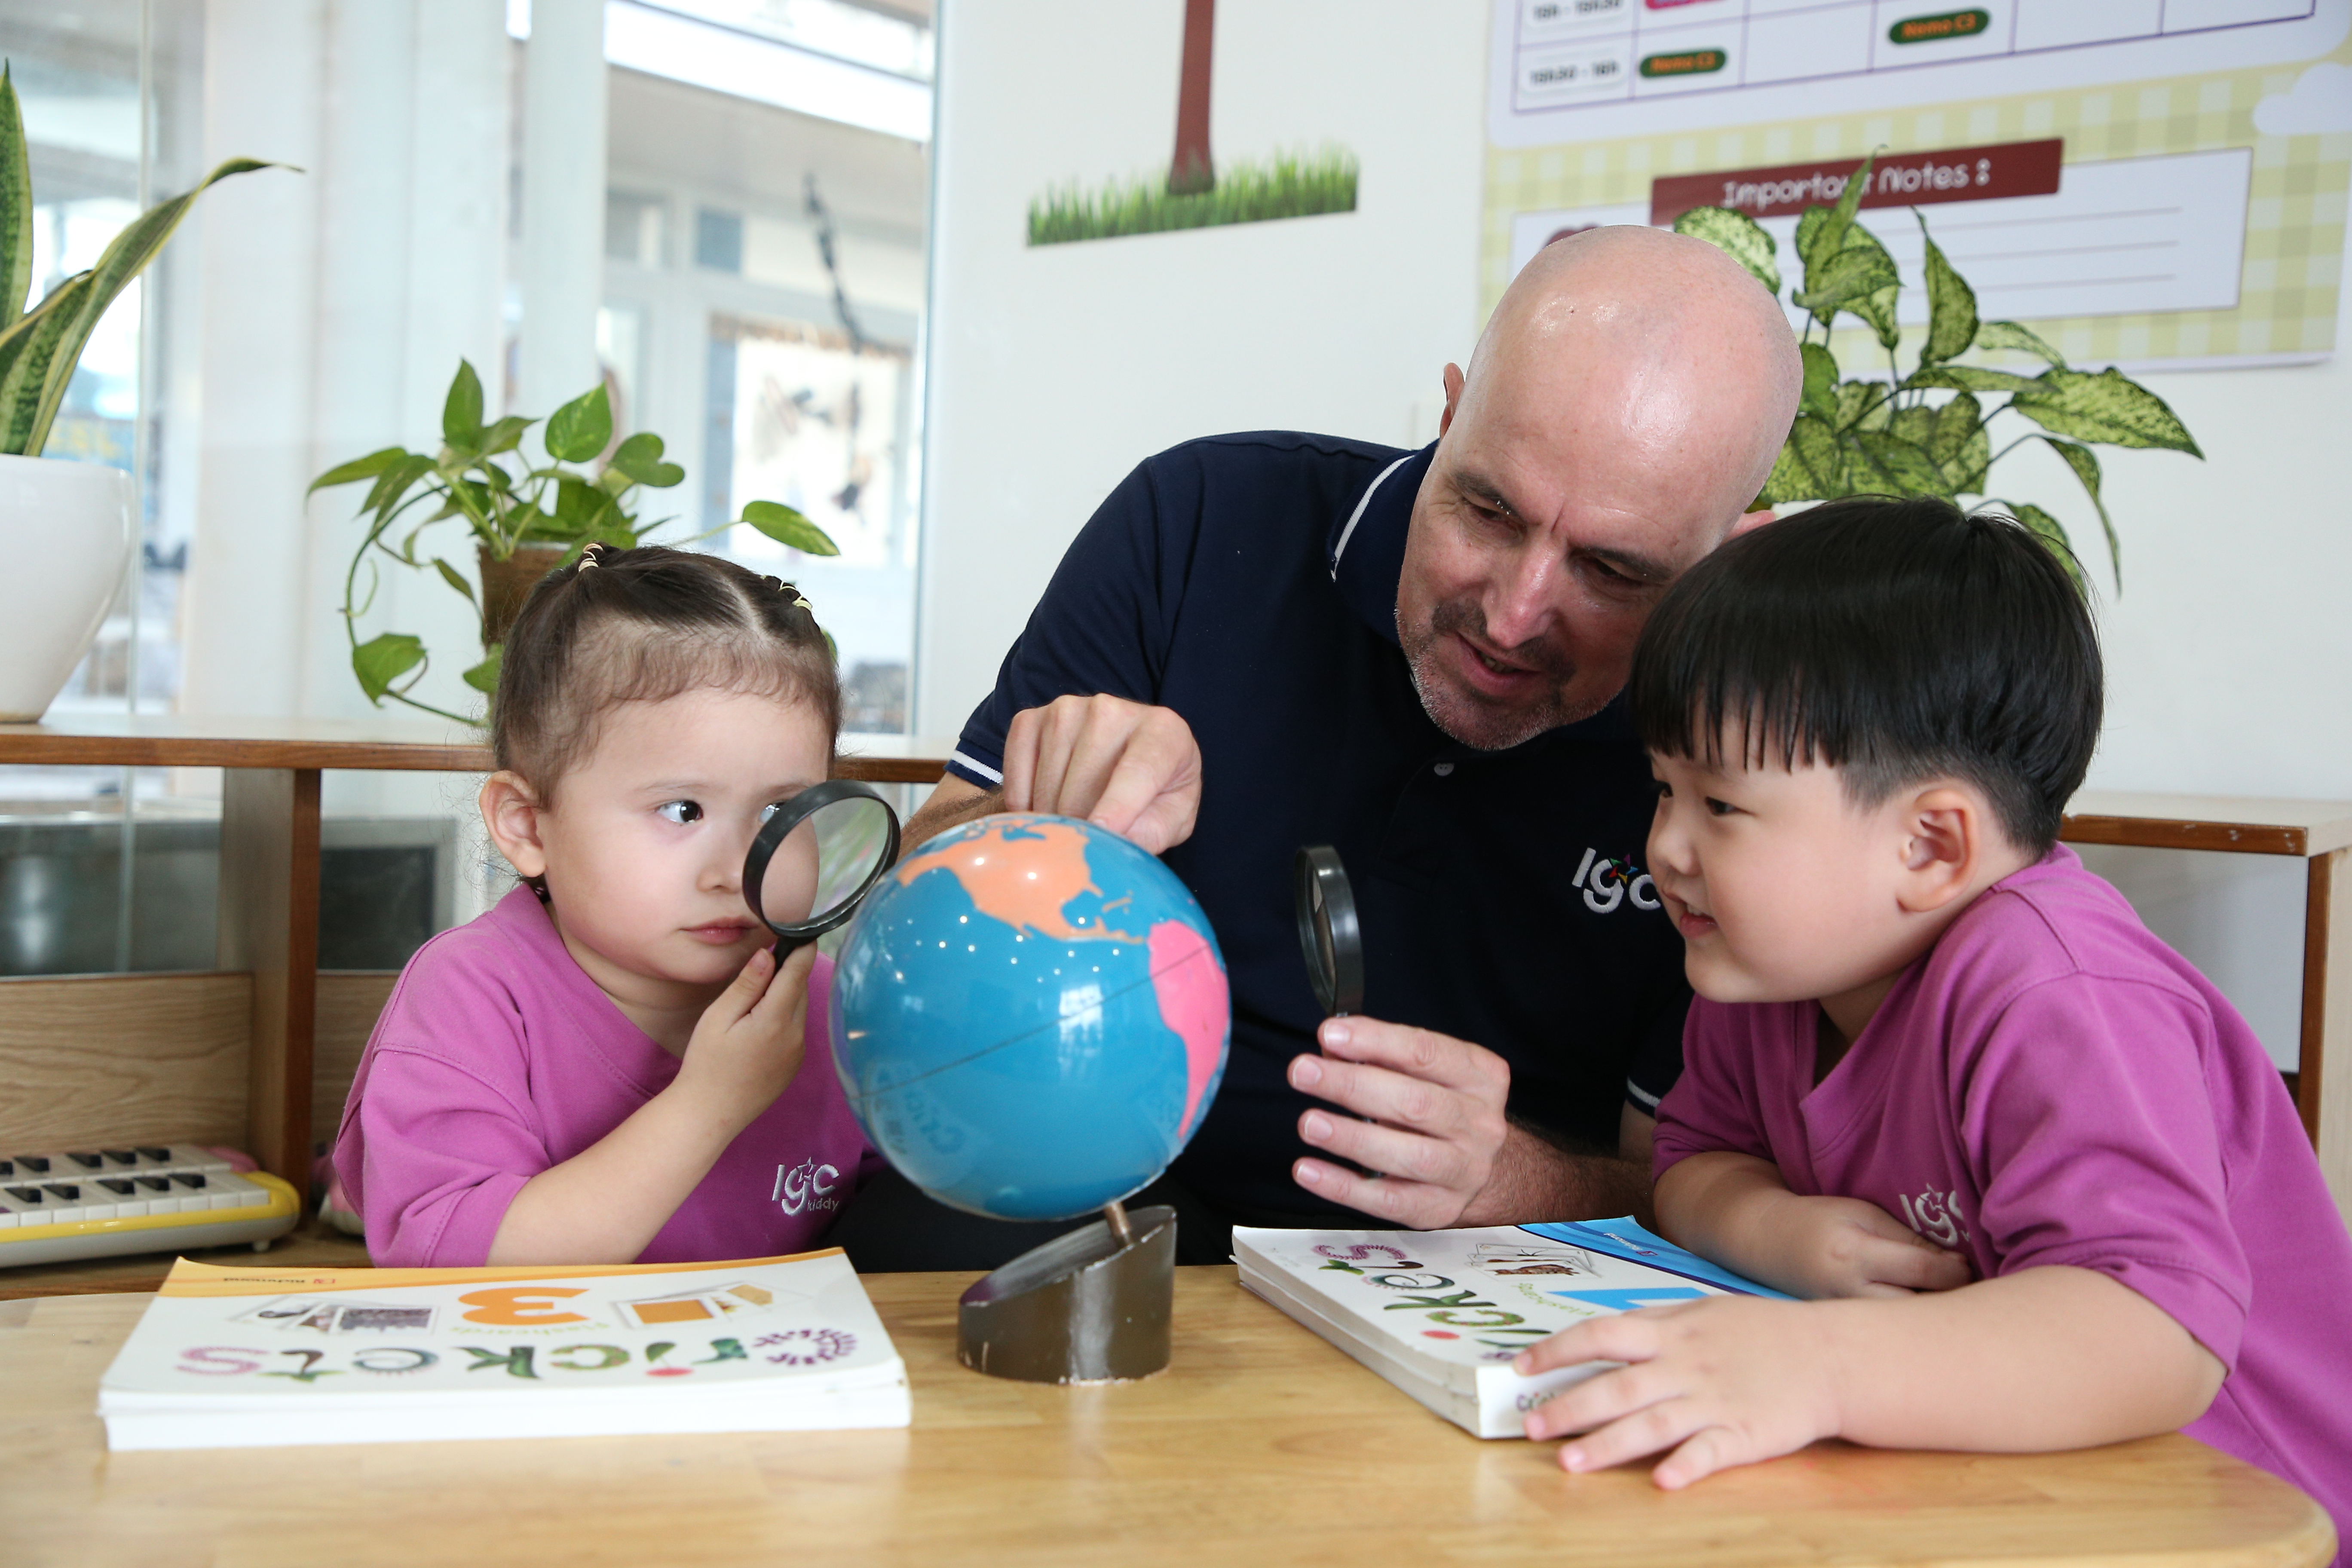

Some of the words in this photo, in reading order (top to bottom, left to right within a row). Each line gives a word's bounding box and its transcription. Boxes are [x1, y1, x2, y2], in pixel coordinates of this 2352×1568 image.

[1722, 171, 1874, 211] Importat
[457, 1286, 591, 1326] 3
[173, 1326, 857, 1383] Crickets
